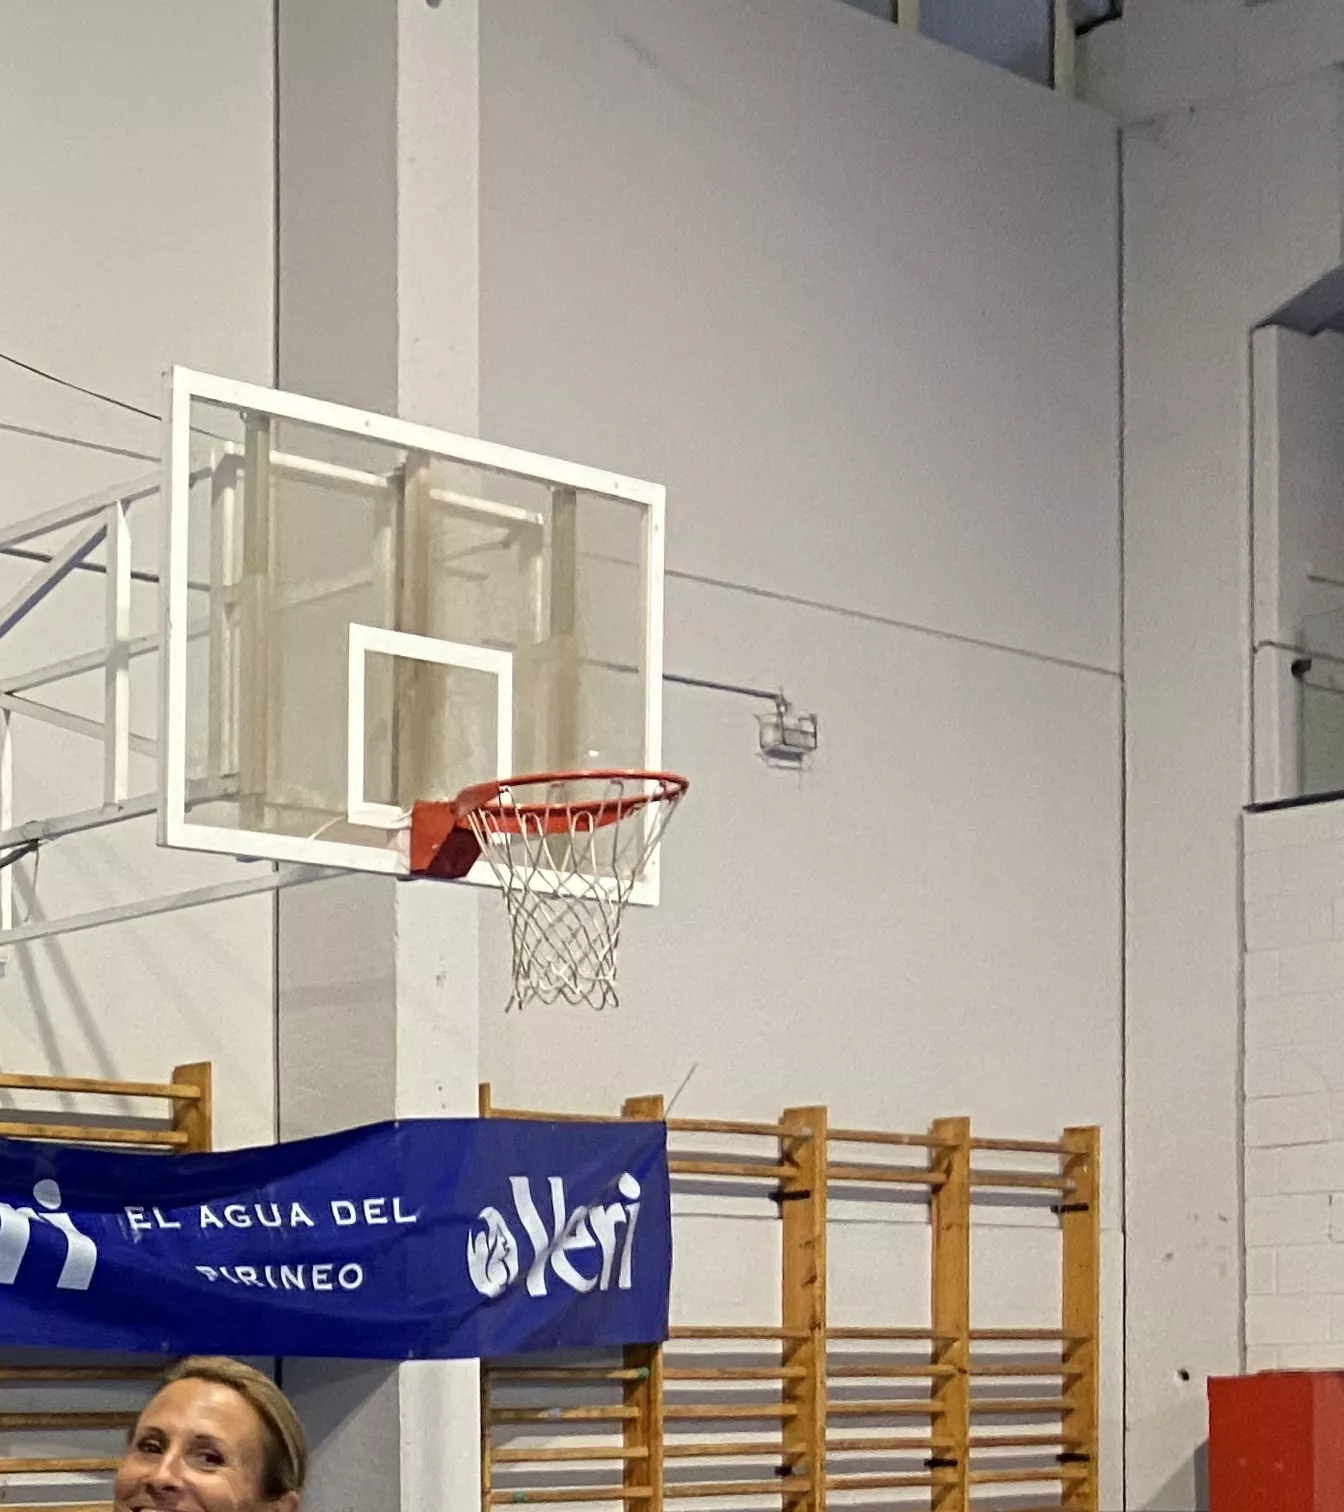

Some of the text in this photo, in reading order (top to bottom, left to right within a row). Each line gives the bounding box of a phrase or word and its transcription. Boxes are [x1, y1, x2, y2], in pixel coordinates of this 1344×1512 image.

[124, 1198, 417, 1229] EL AGUA DEL
[509, 1172, 641, 1297] Veri
